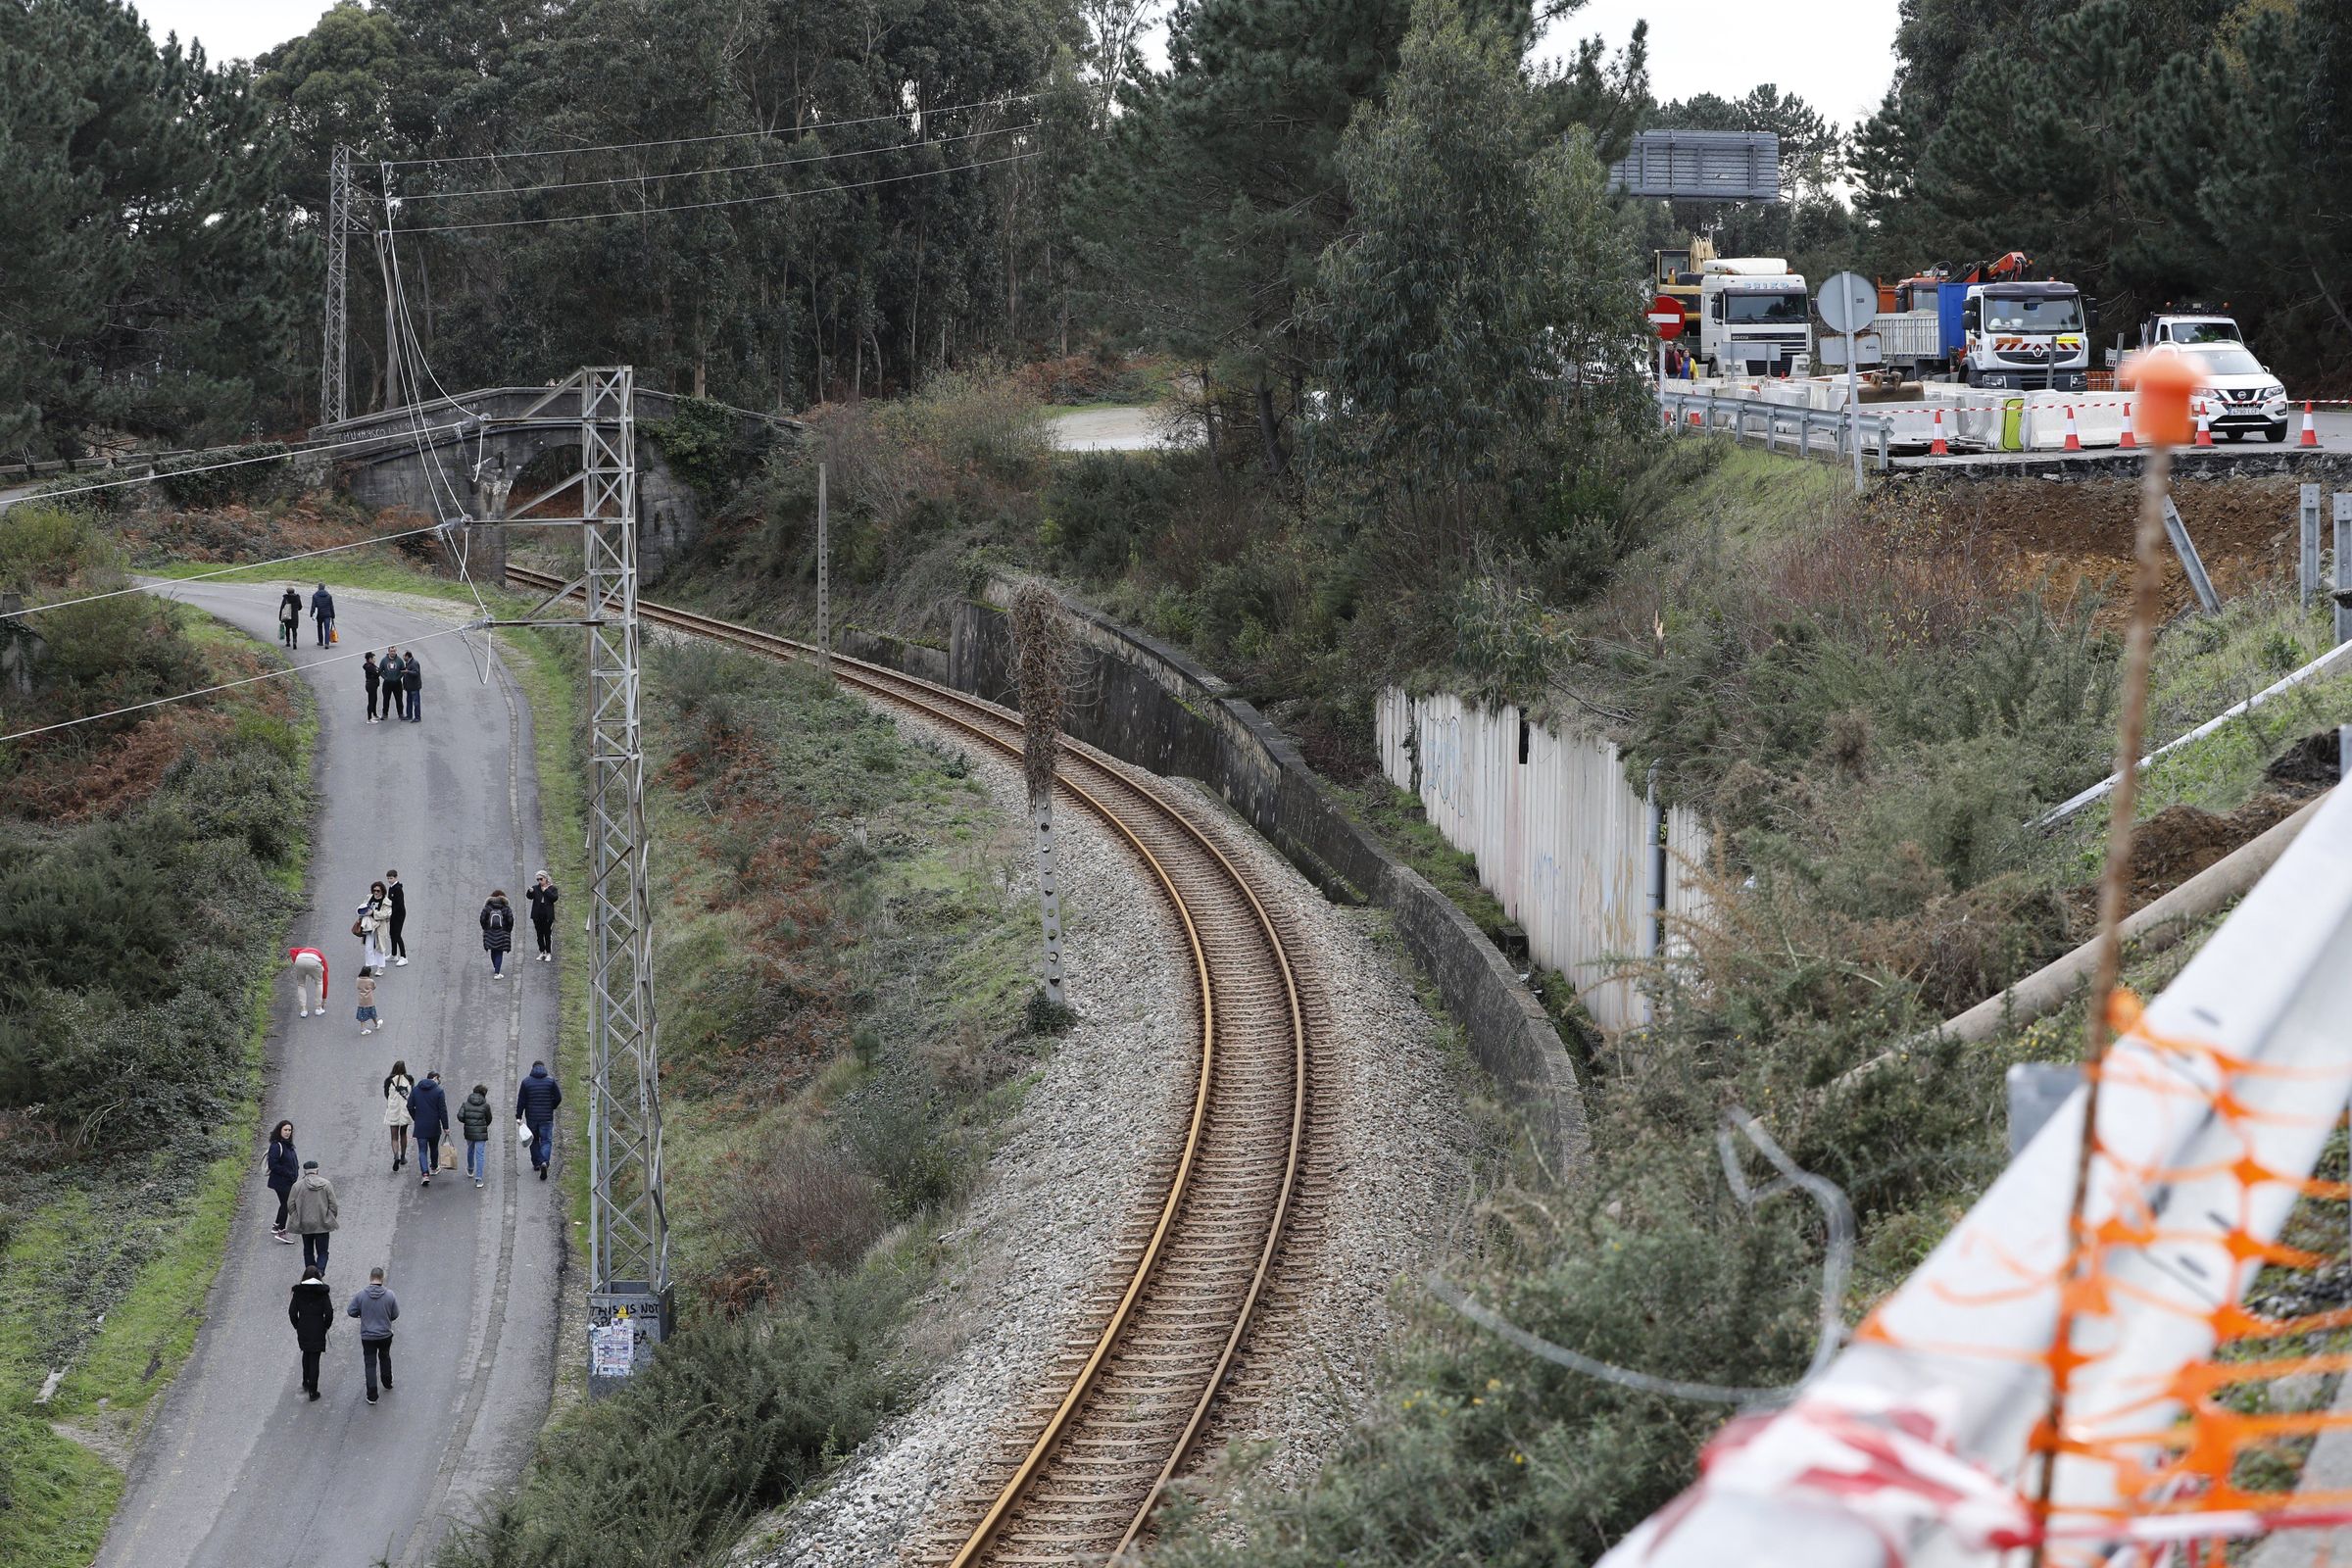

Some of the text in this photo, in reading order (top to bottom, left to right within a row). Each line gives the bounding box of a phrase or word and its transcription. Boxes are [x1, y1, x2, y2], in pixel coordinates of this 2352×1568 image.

[590, 1303, 660, 1317] THIS IS NOT
